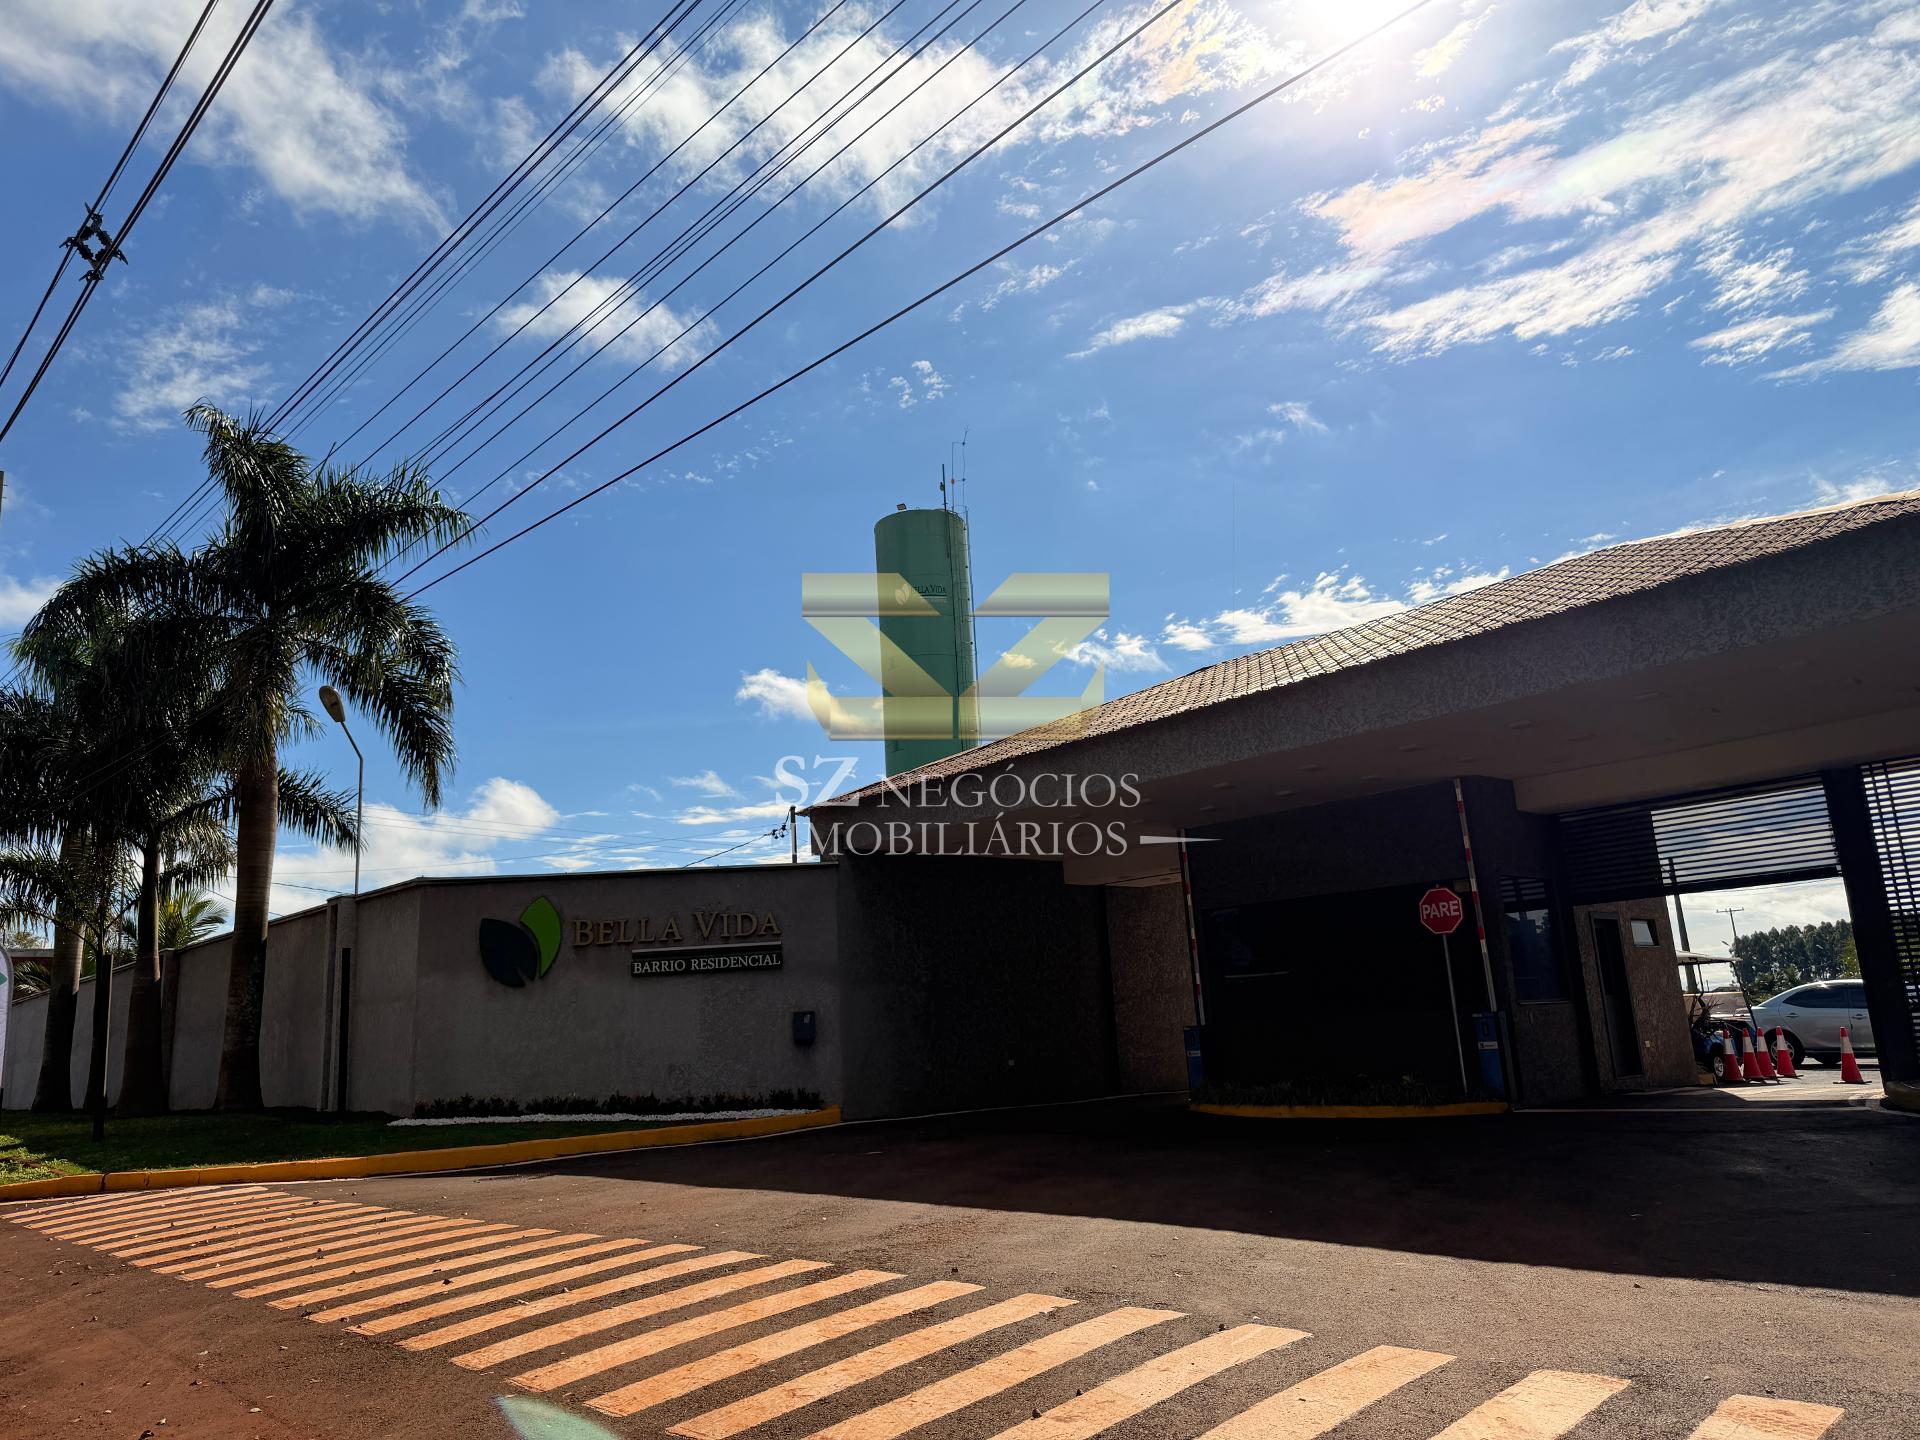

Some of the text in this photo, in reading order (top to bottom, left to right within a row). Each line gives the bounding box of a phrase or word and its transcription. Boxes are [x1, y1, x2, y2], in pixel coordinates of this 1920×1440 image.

[1423, 900, 1460, 919] PARE
[574, 912, 781, 946] BELLA VIDA
[633, 955, 780, 974] BARRIO RESIDENCIAL
